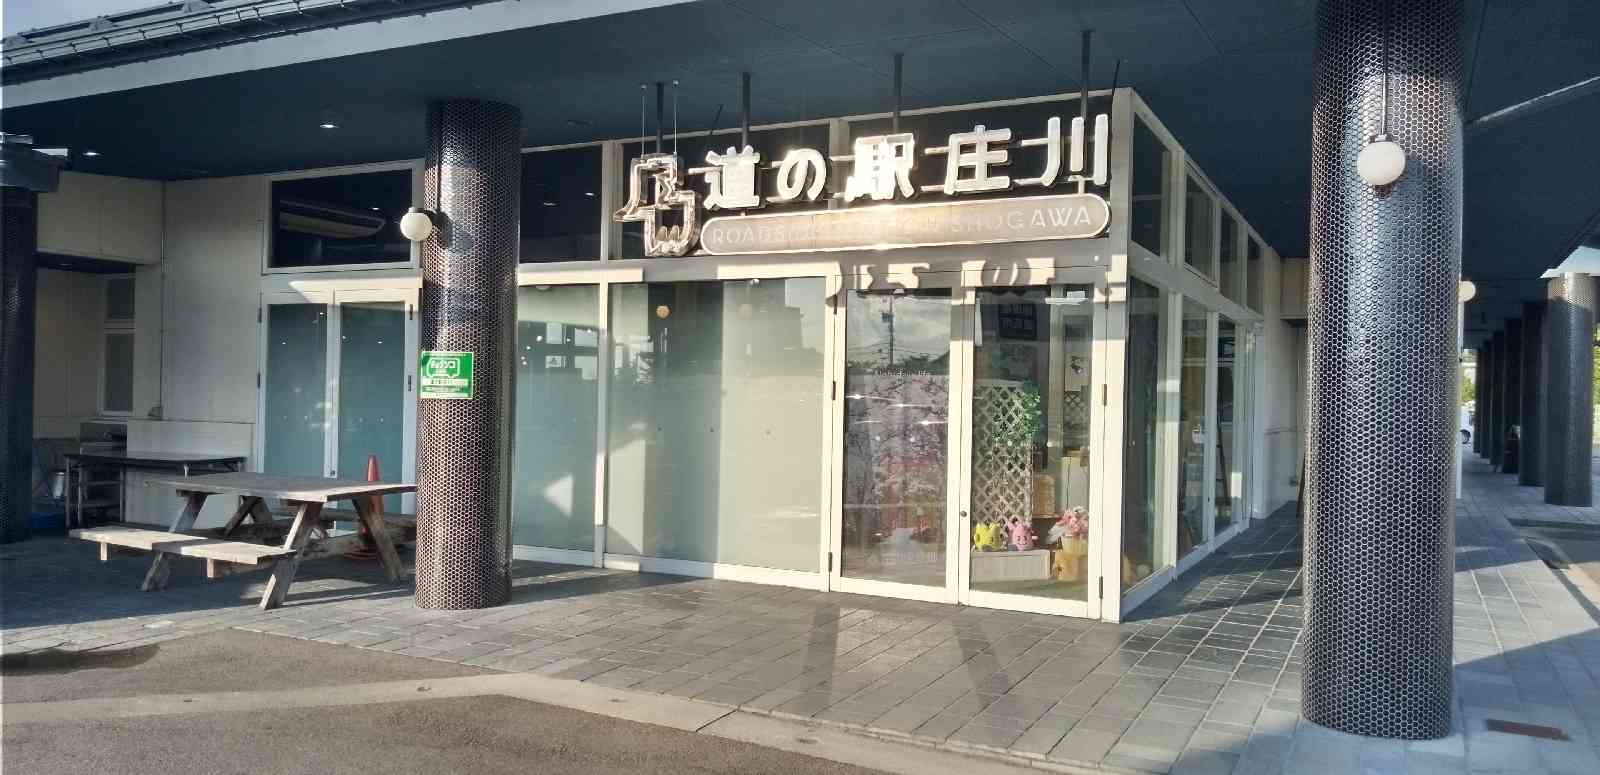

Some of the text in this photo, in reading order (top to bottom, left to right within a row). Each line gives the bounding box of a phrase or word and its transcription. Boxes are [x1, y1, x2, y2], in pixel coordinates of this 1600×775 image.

[704, 114, 1109, 209] 道の駅庄川
[951, 206, 1091, 233] SHOGAWA
